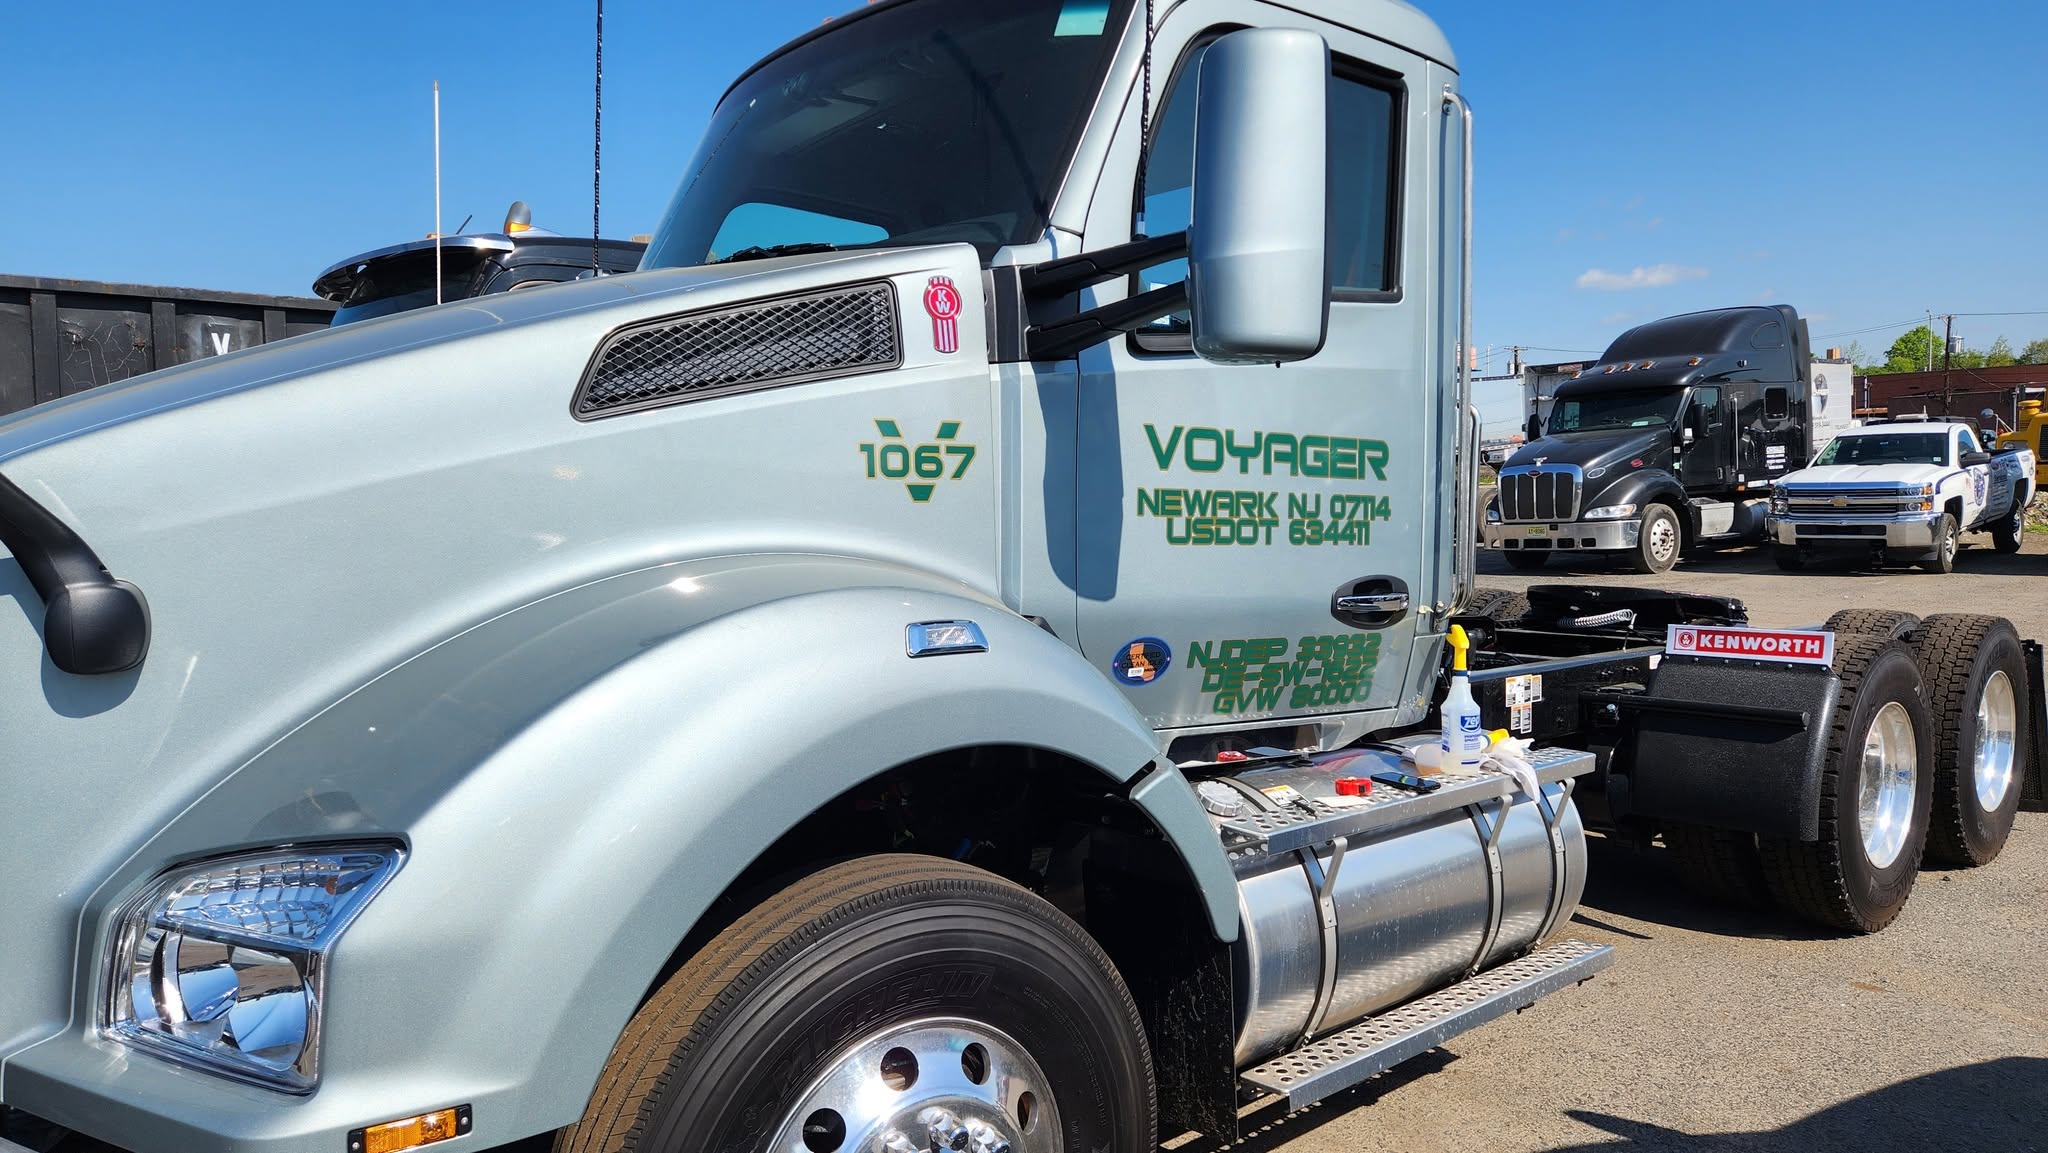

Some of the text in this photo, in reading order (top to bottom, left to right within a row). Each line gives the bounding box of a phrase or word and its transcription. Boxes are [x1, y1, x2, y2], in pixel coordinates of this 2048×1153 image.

[859, 441, 976, 480] 1067
[1143, 423, 1390, 481] VOYAGER
[1136, 487, 1391, 521] NEWARK NJ 07114
[1166, 517, 1370, 546] USDOT 634411
[1186, 637, 1289, 668] NJDEP
[1700, 634, 1821, 654] KENWORTH
[1212, 681, 1373, 714] GVW 80000
